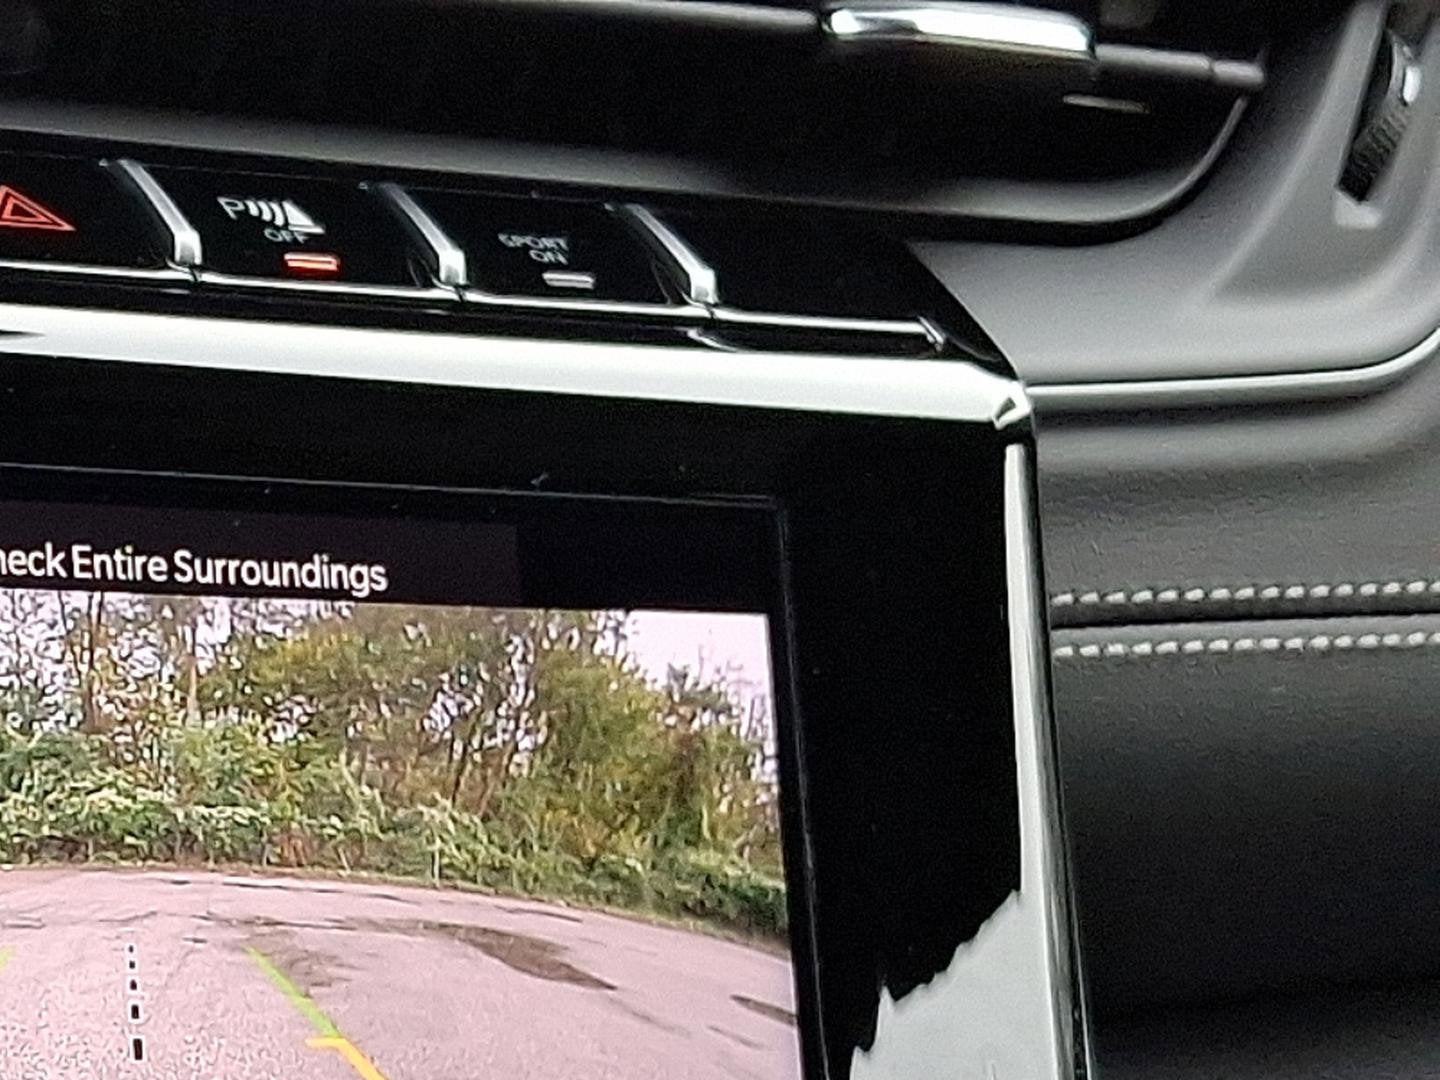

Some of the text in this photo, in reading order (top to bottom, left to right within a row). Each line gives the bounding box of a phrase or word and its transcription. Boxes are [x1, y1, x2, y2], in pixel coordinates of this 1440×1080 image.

[264, 227, 309, 244] OFF
[498, 233, 569, 250] SPORT
[71, 543, 169, 583] Entire
[172, 549, 389, 598] Surroundings
